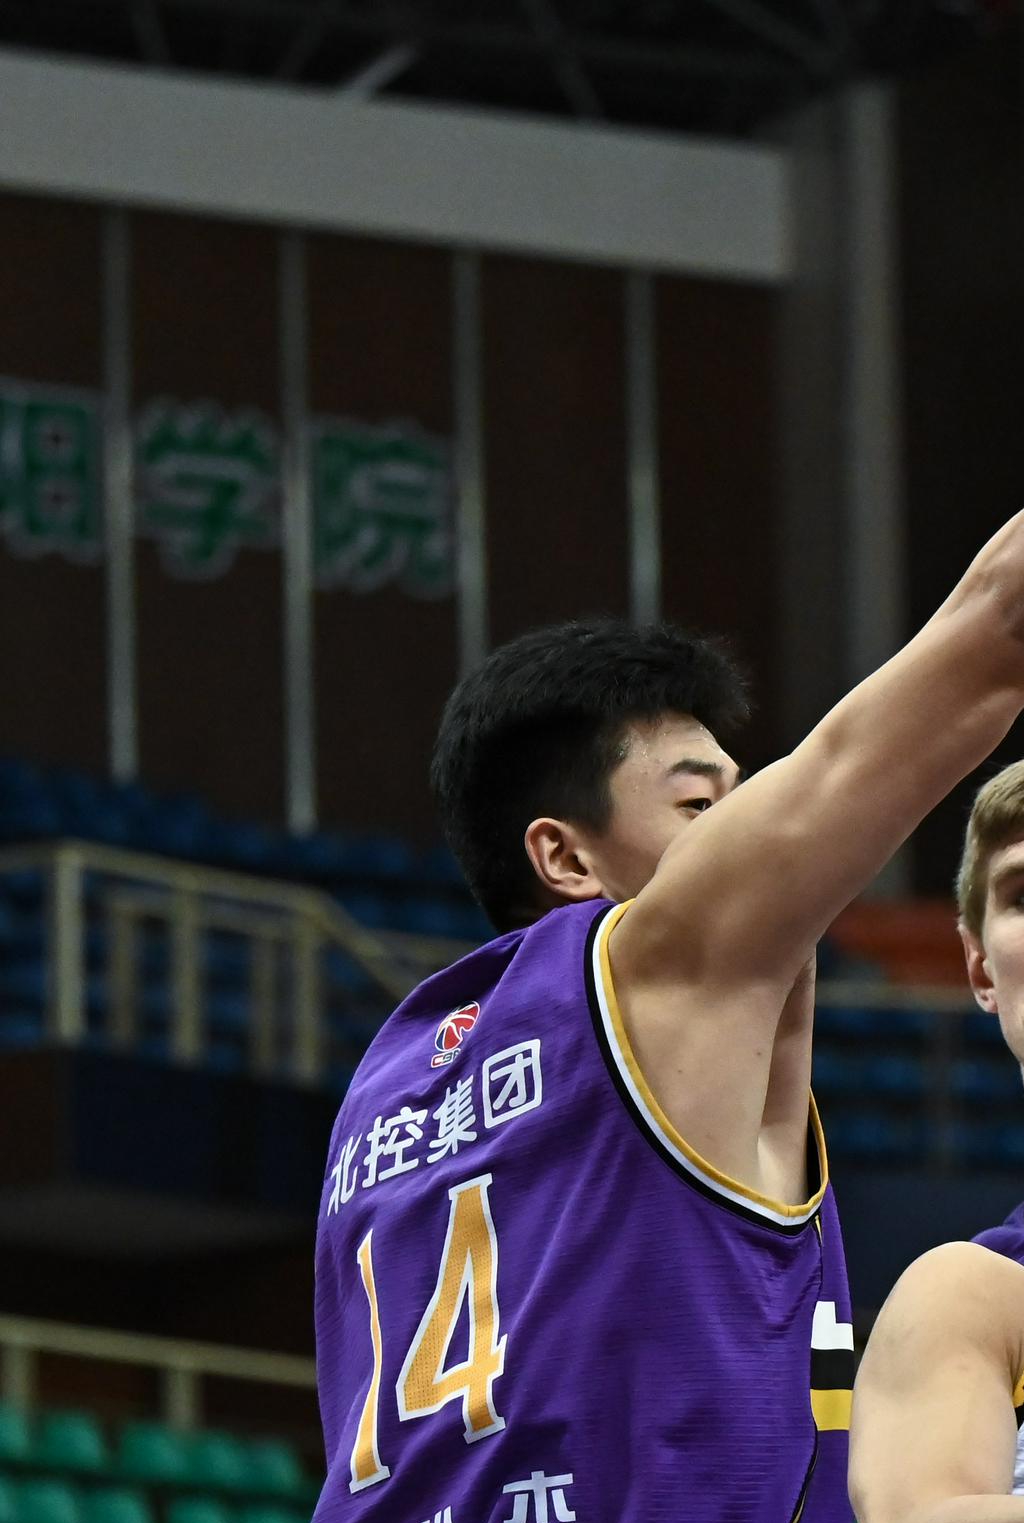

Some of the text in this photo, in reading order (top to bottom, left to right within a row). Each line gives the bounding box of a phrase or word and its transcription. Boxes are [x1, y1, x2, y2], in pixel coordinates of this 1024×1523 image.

[327, 1039, 542, 1216] 北控集团
[349, 1172, 508, 1494] 14
